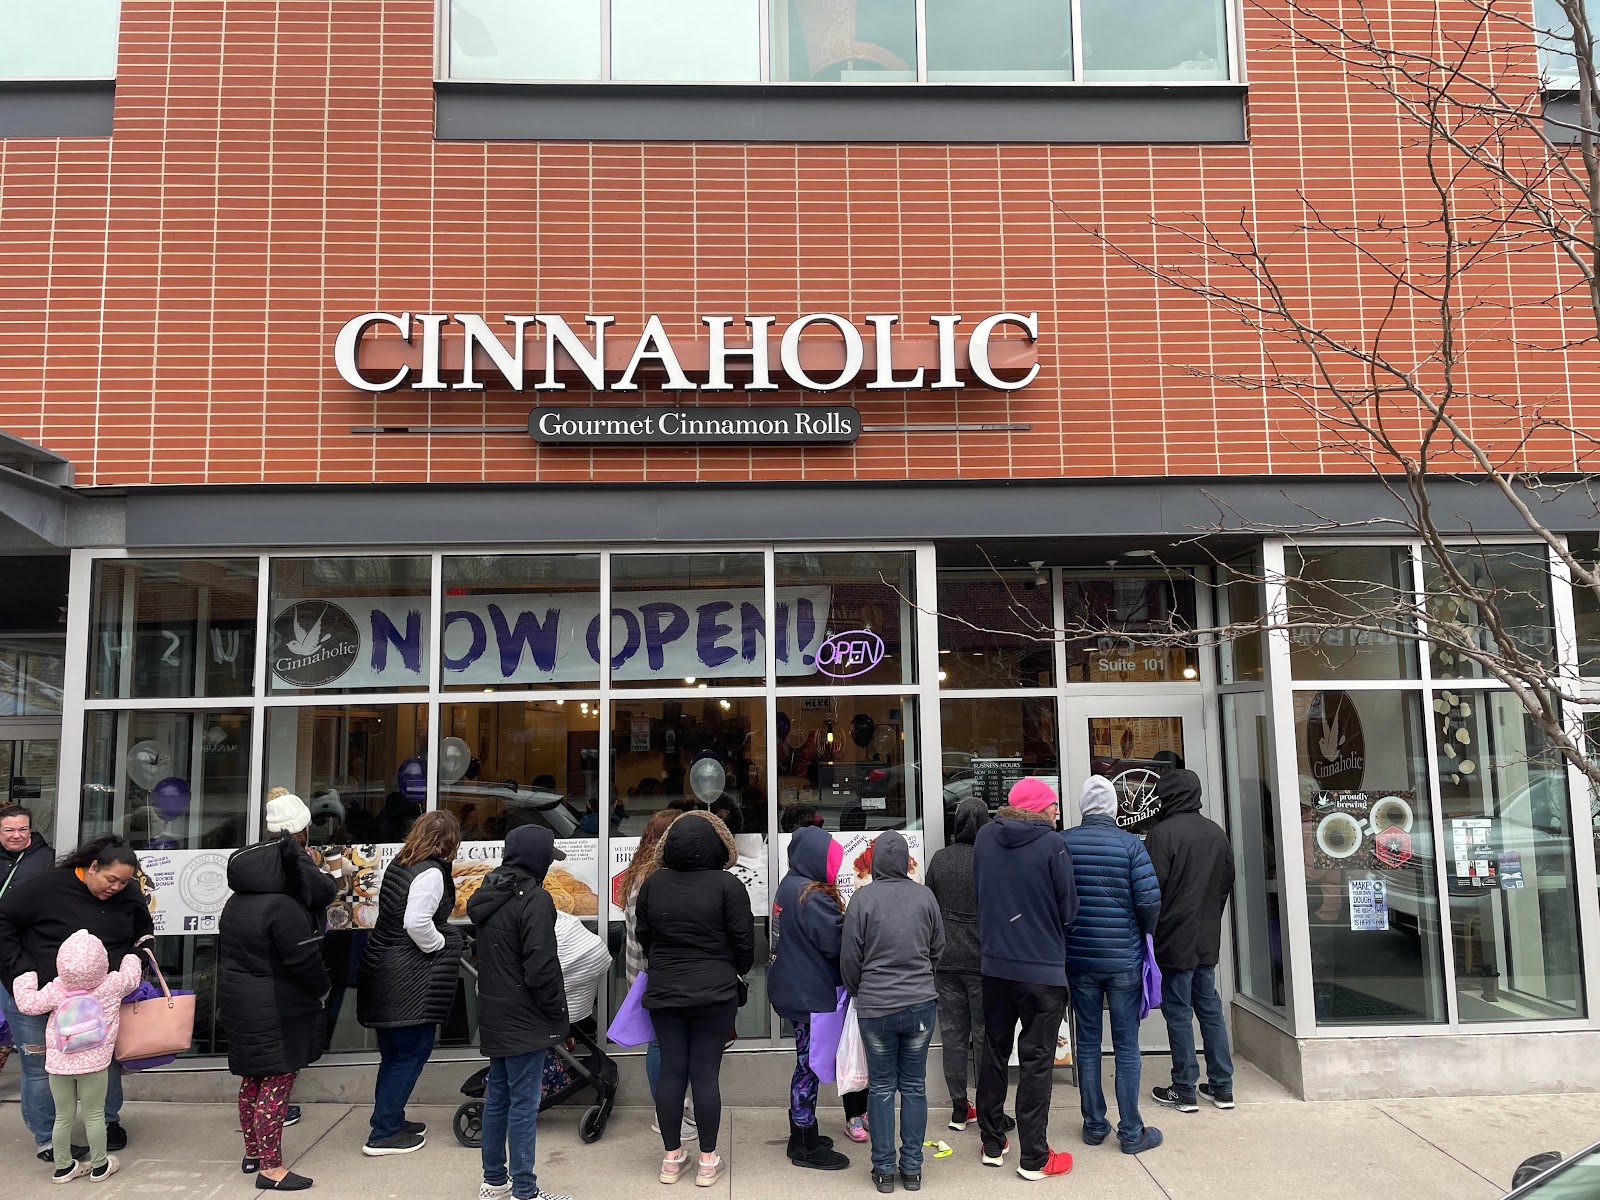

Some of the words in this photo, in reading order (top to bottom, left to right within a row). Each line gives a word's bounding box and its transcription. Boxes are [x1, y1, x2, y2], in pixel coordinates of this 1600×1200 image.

[334, 311, 1041, 393] CINNAHOLIC
[538, 412, 653, 436] Gourmet
[658, 412, 790, 435] Cinnamon
[794, 412, 852, 434] Rolls
[370, 603, 561, 677] NOW
[586, 597, 816, 671] OPEN!
[275, 641, 357, 672] Cinnaholic
[818, 638, 880, 665] OPEN
[1098, 658, 1136, 672] Suite
[1142, 658, 1165, 671] 101
[805, 698, 830, 708] HERE
[1313, 750, 1364, 778] Cinnaholic
[1336, 801, 1368, 810] brewing
[1339, 792, 1369, 803] proudly
[1115, 803, 1162, 828] Cinnaho
[838, 877, 852, 885] HOT
[1352, 881, 1370, 890] MAKE
